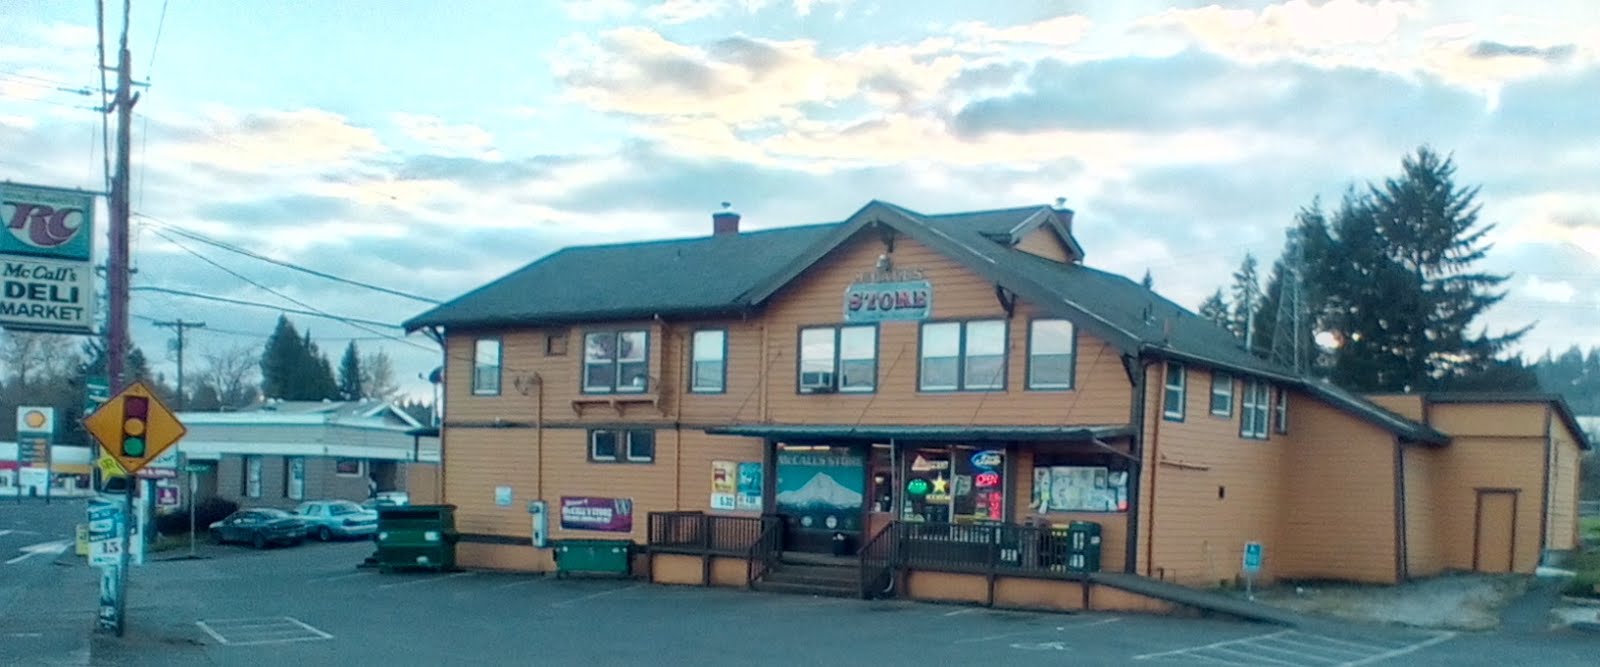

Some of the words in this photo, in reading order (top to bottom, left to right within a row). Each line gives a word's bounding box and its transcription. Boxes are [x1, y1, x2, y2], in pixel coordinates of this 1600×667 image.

[4, 202, 83, 246] RC
[4, 263, 77, 282] McCall's
[4, 281, 79, 303] DELI
[847, 291, 928, 312] STORE
[0, 303, 83, 321] MARKET
